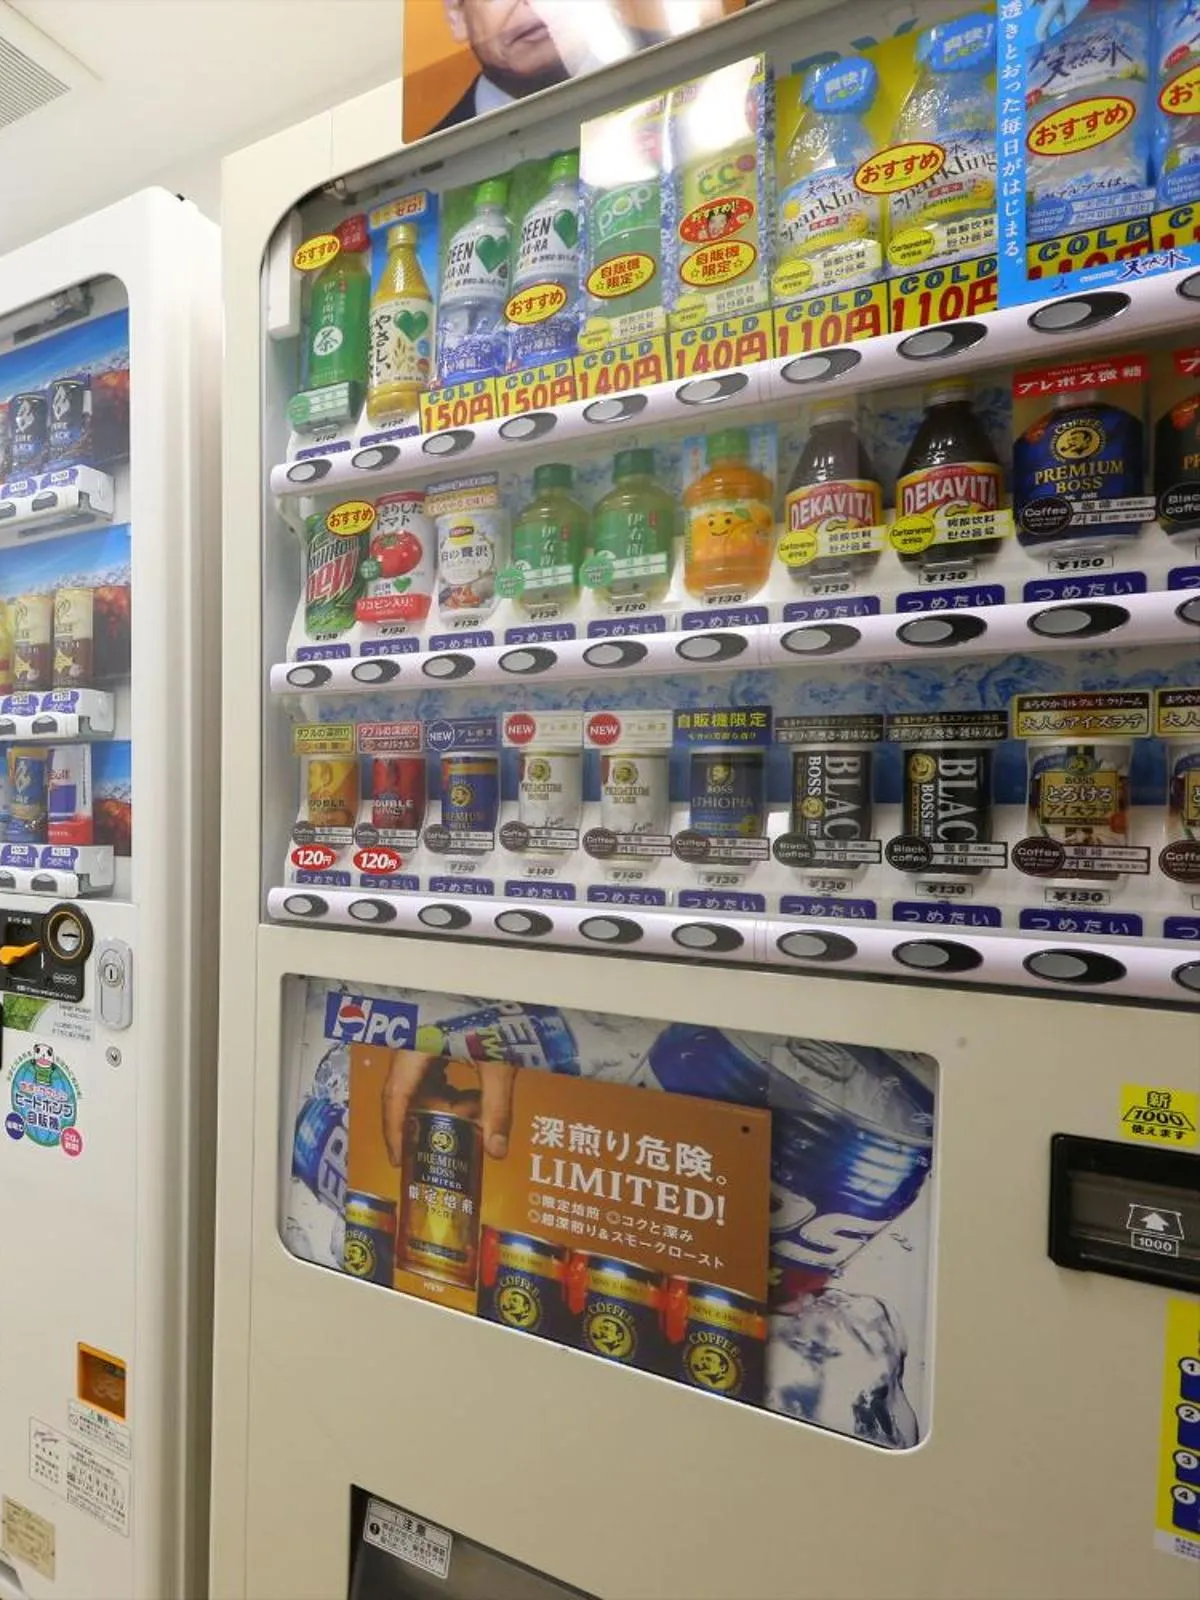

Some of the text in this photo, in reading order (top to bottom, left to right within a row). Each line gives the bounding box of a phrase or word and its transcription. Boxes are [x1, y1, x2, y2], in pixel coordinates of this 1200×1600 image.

[1035, 103, 1128, 146] おすすめ
[861, 149, 940, 185] おすすめ
[296, 240, 340, 265] おすすめ
[1038, 221, 1150, 263] COLD
[900, 257, 998, 295] COLD
[508, 291, 564, 318] おすすめ
[785, 290, 874, 323] COLD
[893, 276, 998, 339] 110円
[681, 316, 759, 346] COLD
[778, 303, 880, 351] 110円
[584, 341, 654, 369] COLD
[676, 331, 767, 379] 140円
[504, 358, 569, 390] COLD
[580, 354, 663, 396] 140円
[428, 380, 487, 405] COLD
[501, 376, 576, 416] 150円
[424, 394, 494, 435] 150円
[1034, 461, 1125, 486] PREMIUM
[904, 474, 997, 516] DEKAVITA
[1055, 475, 1105, 494] BOSS
[330, 508, 374, 529] おすすめ
[790, 490, 874, 530] DEKAVITA
[1024, 506, 1069, 519] Coffee
[1054, 558, 1106, 570] ¥150
[924, 570, 969, 584] ¥130
[812, 582, 851, 595] ¥130
[1034, 579, 1135, 602] つめたい
[792, 602, 872, 620] つめたい
[906, 592, 995, 613] つめたい
[595, 622, 658, 639] つめたい
[690, 611, 761, 630] つめたい
[435, 636, 490, 652] つめたい
[511, 629, 569, 646] つめたい
[508, 723, 534, 736] NEW
[590, 722, 618, 736] NEW
[678, 711, 768, 729] 自販機限定
[1022, 715, 1144, 732] 大人のアイスラテ
[430, 730, 452, 743] NEW
[807, 755, 822, 797] BOSS
[823, 754, 862, 841] BLAC
[920, 783, 934, 820] BOSS
[937, 754, 978, 842] BLAC
[1047, 785, 1113, 802] とろける
[297, 849, 333, 866] 120円
[359, 851, 398, 869] 120円
[435, 880, 489, 896] つめたい
[511, 886, 569, 900] つめたい
[593, 889, 658, 906] つめたい
[1052, 889, 1104, 904] ¥130
[686, 895, 757, 912] つめたい
[789, 902, 868, 920] つめたい
[903, 909, 990, 928] つめたい
[1031, 915, 1130, 936] つめたい
[15, 1092, 73, 1118] ヒートポンプ
[1147, 1091, 1171, 1109] 新
[27, 1111, 60, 1132] 自販機
[1133, 1109, 1184, 1127] 1000
[1131, 1124, 1186, 1140] 使えます
[530, 1115, 728, 1186] 深煎り危険。
[417, 1151, 468, 1174] PREMIUM
[427, 1166, 456, 1180] BOSS
[421, 1174, 463, 1190] LIMITED
[529, 1153, 727, 1227] LIMITED!
[1138, 1237, 1173, 1251] 1000
[588, 1301, 637, 1325] COFFEE
[688, 1331, 743, 1359] COFFEE
